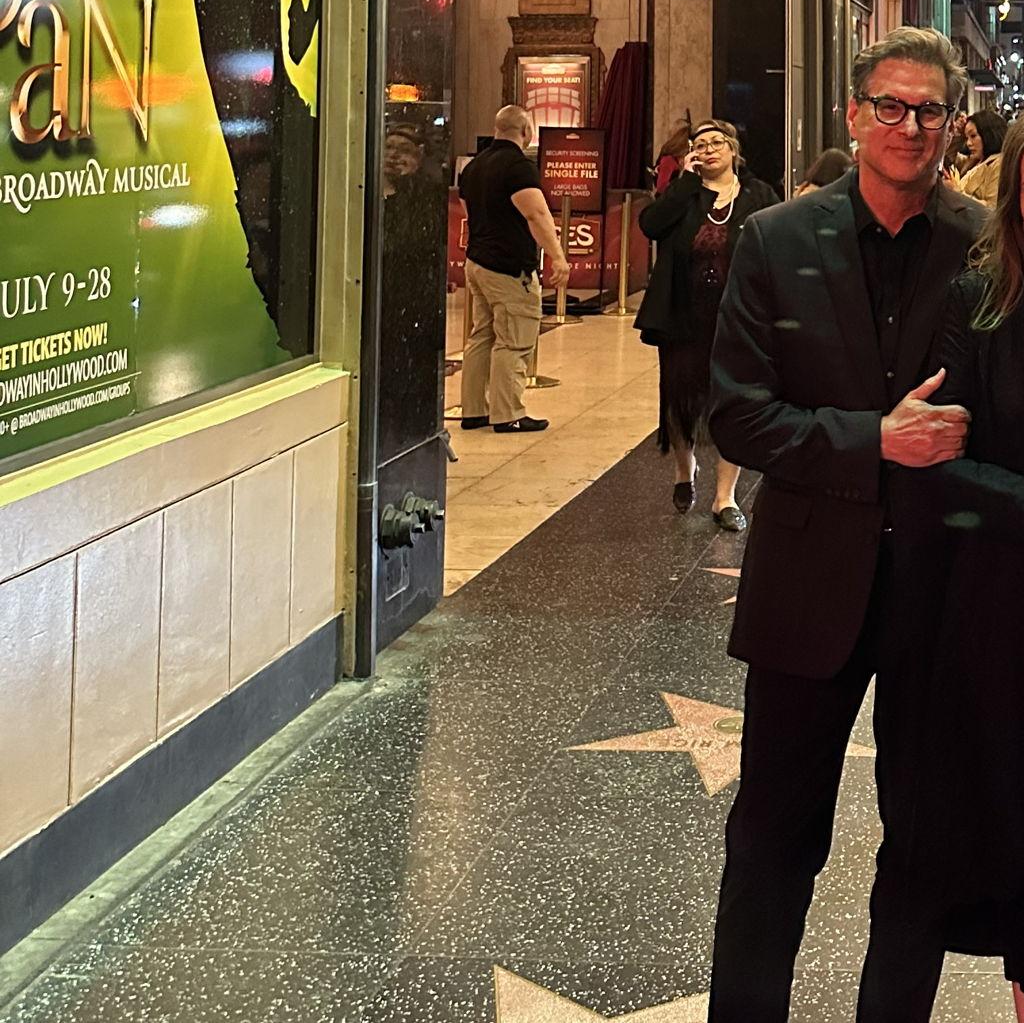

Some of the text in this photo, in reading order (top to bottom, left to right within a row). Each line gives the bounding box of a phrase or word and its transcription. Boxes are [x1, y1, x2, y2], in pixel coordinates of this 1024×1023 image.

[112, 163, 191, 194] MUSICAL
[544, 170, 599, 178] SINGLE FILE
[1, 266, 111, 319] ULY 9-28
[20, 331, 72, 365] TICKETS
[73, 322, 108, 352] NOW!
[0, 348, 128, 407] DWAYINHOLLYWOOD.COM
[0, 422, 9, 435] 0+
[11, 417, 19, 435] @
